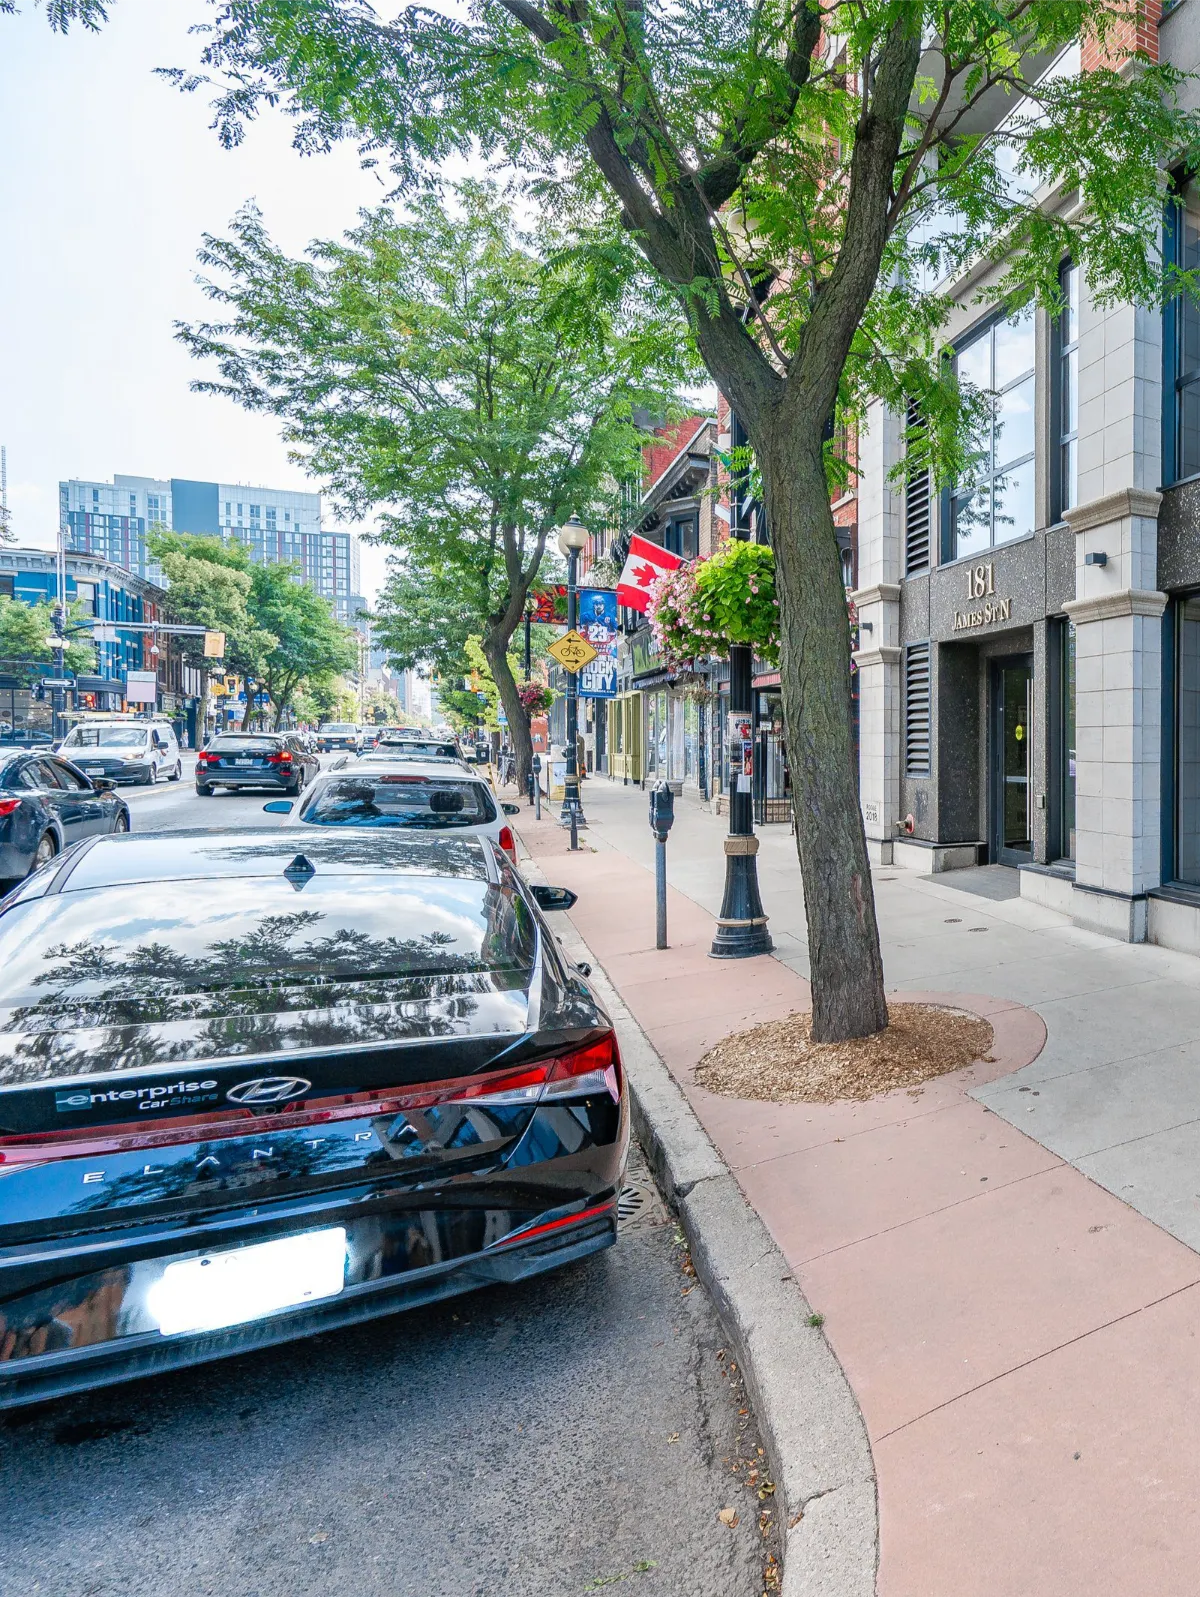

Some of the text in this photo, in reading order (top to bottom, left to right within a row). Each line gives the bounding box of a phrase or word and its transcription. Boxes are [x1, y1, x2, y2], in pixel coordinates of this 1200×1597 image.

[965, 562, 996, 600] 181
[952, 610, 983, 631] JAMES
[1000, 598, 1012, 621] N
[589, 625, 608, 643] 23
[583, 660, 614, 675] ROCK
[582, 673, 614, 690] CITY
[57, 1079, 218, 1106] enterprise
[82, 1124, 419, 1184] ELANTRA
